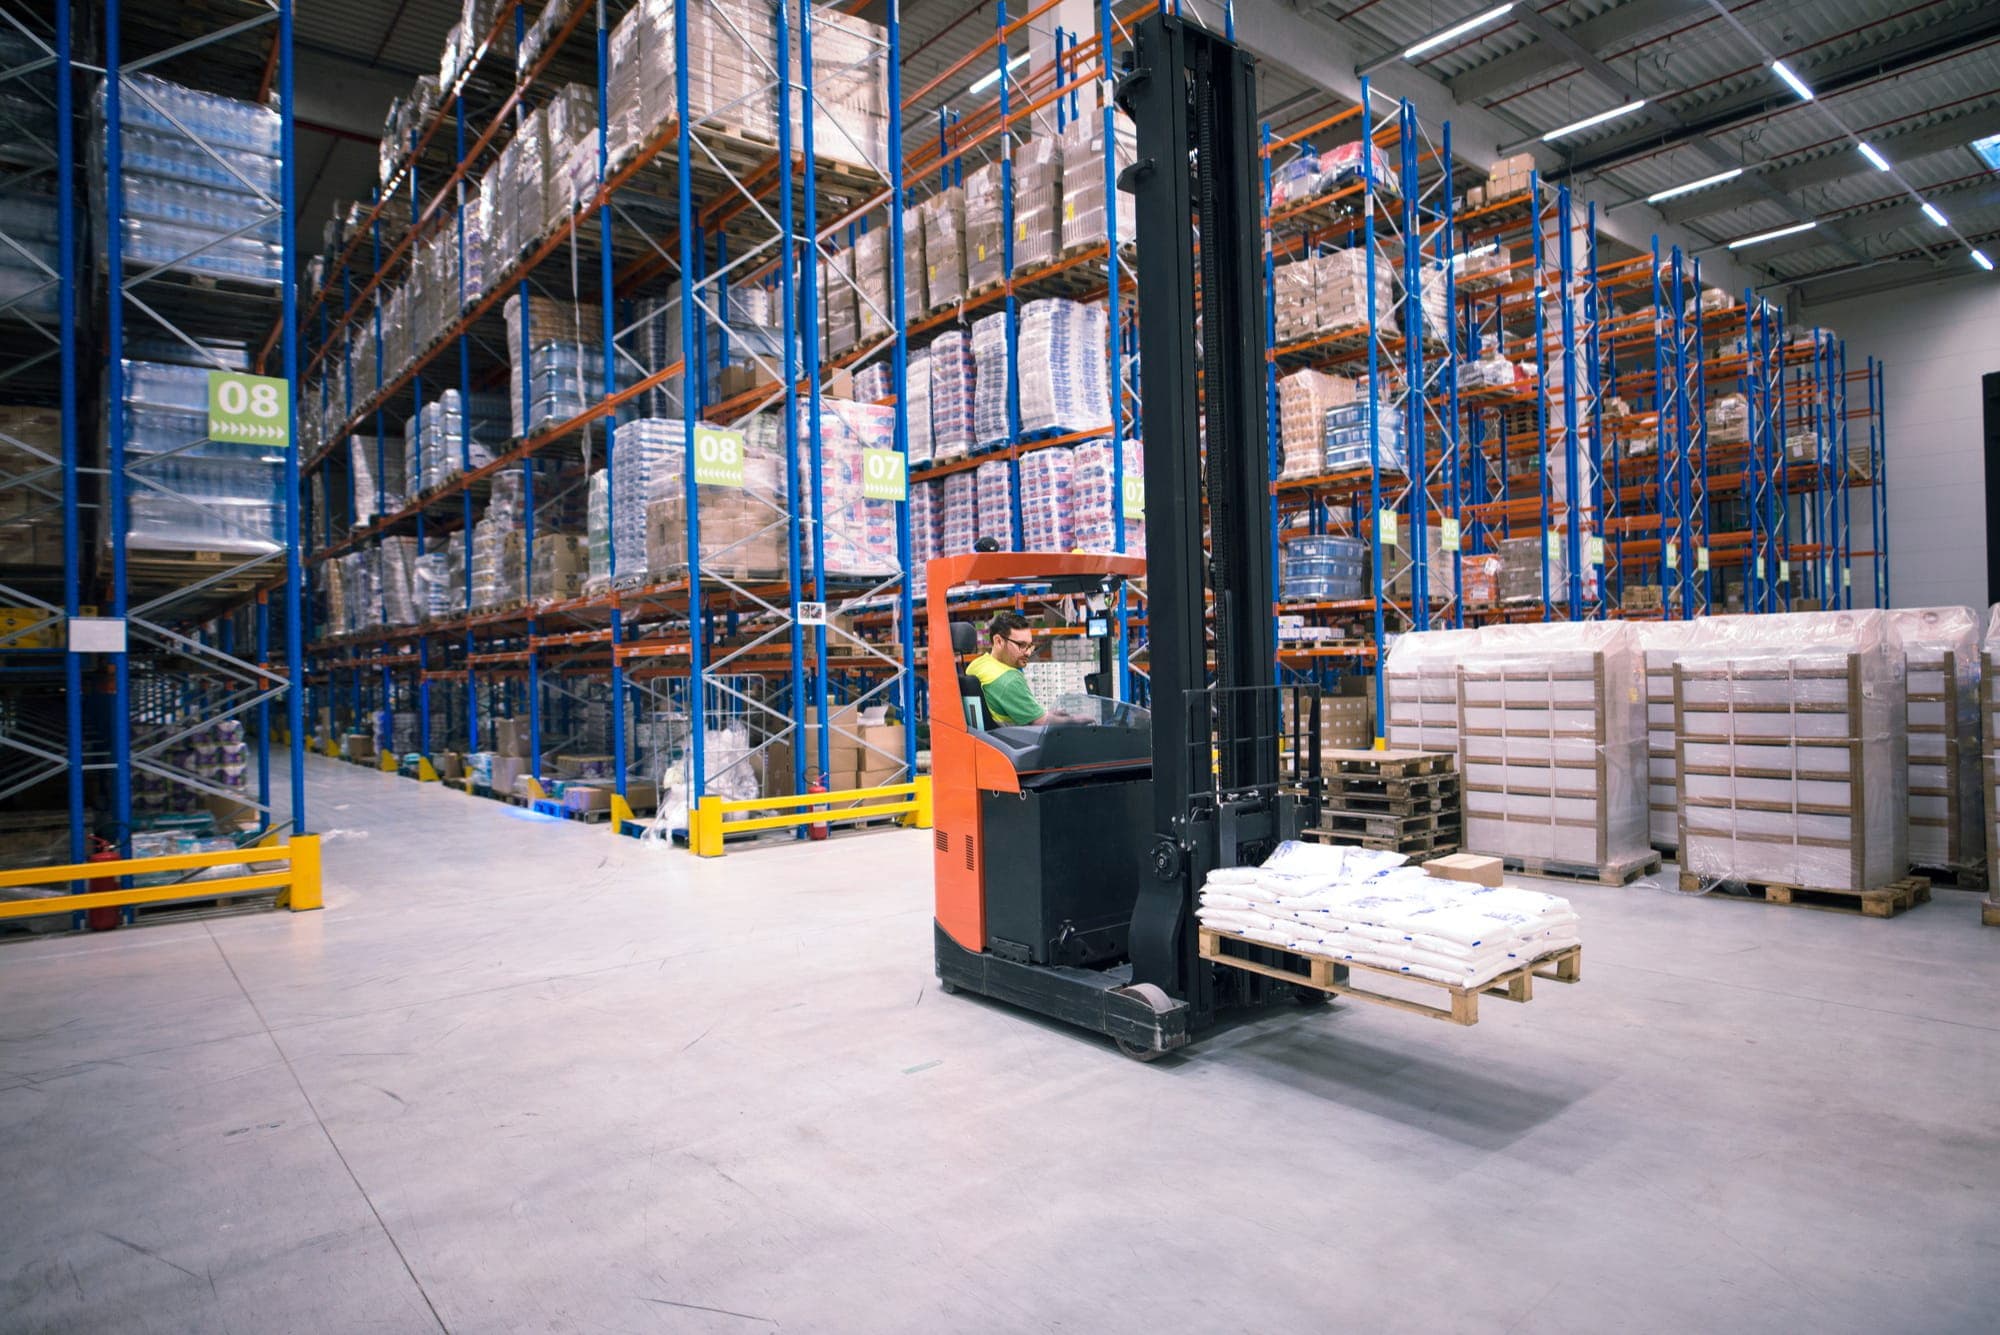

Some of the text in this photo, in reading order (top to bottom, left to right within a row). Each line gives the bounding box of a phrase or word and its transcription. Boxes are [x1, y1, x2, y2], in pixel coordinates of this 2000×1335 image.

[218, 381, 279, 418] 08
[700, 435, 738, 465] 08
[868, 454, 900, 481] 07
[1125, 482, 1145, 502] 07
[1444, 523, 1457, 538] 05
